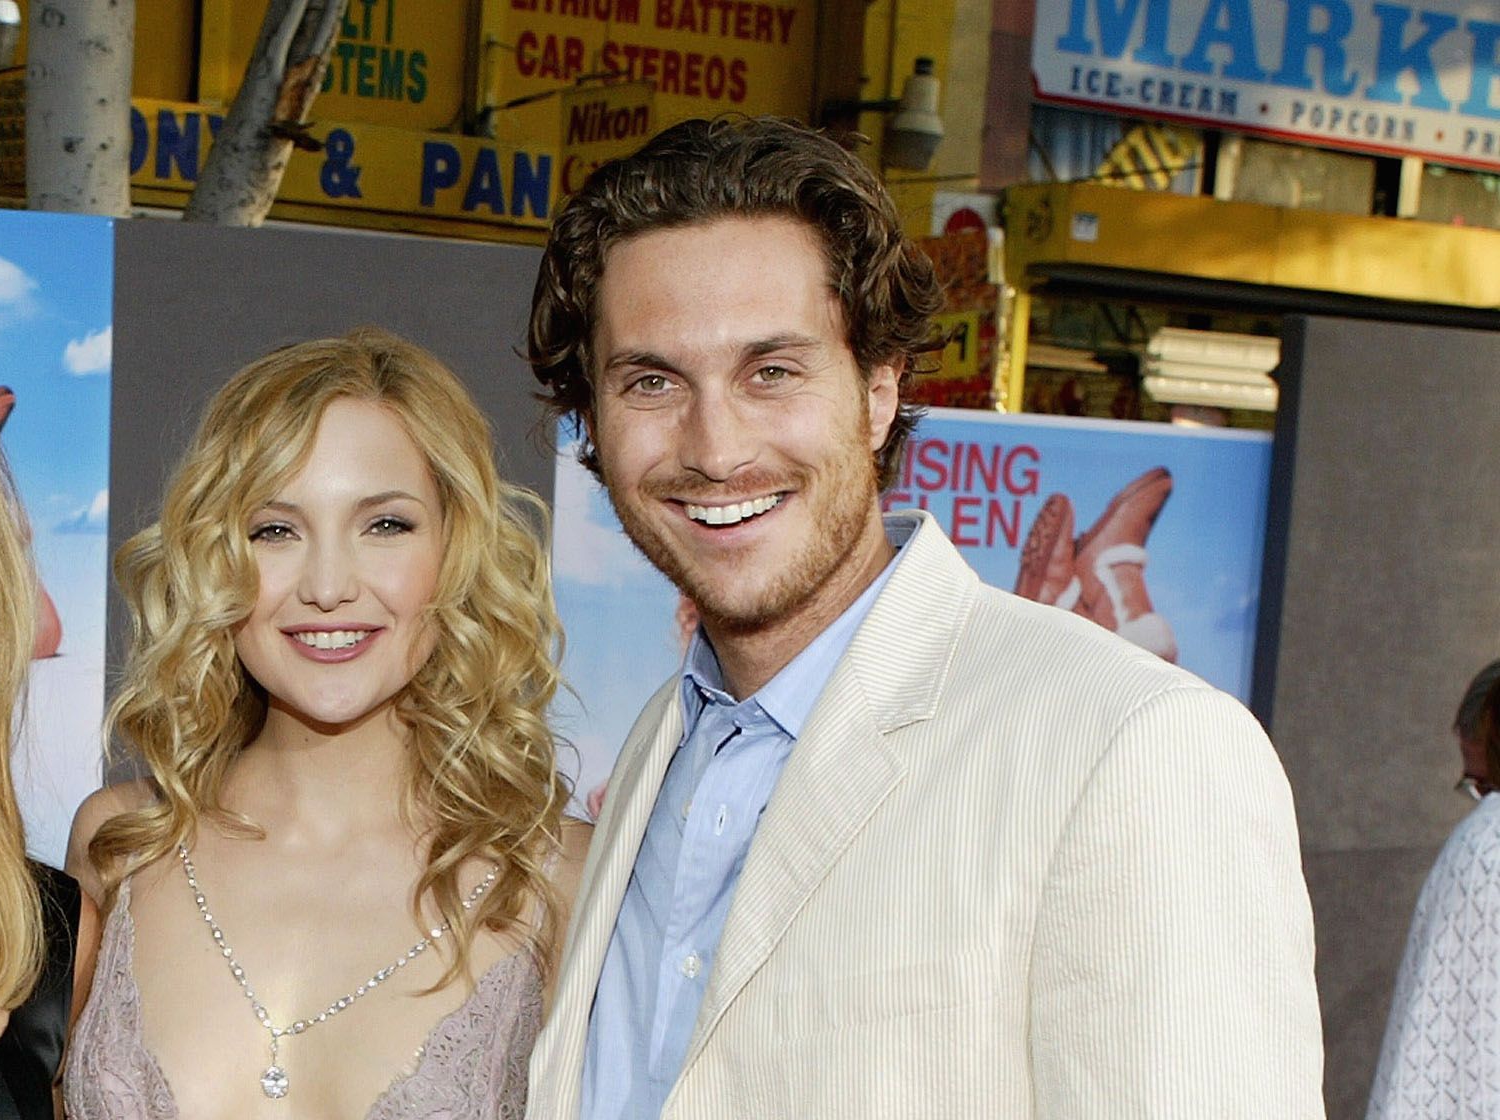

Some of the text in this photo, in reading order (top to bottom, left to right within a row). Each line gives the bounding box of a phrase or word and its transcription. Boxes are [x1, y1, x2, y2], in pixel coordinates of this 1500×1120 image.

[511, 0, 797, 43] HIUM BATTERY
[516, 31, 749, 103] CAR STEREOS
[566, 101, 650, 146] Nikon
[1070, 66, 1238, 116] ICE-CREAM
[1290, 100, 1417, 142] POPCORN
[320, 128, 362, 198] &
[421, 141, 551, 219] PAN
[902, 438, 1042, 496] ISING
